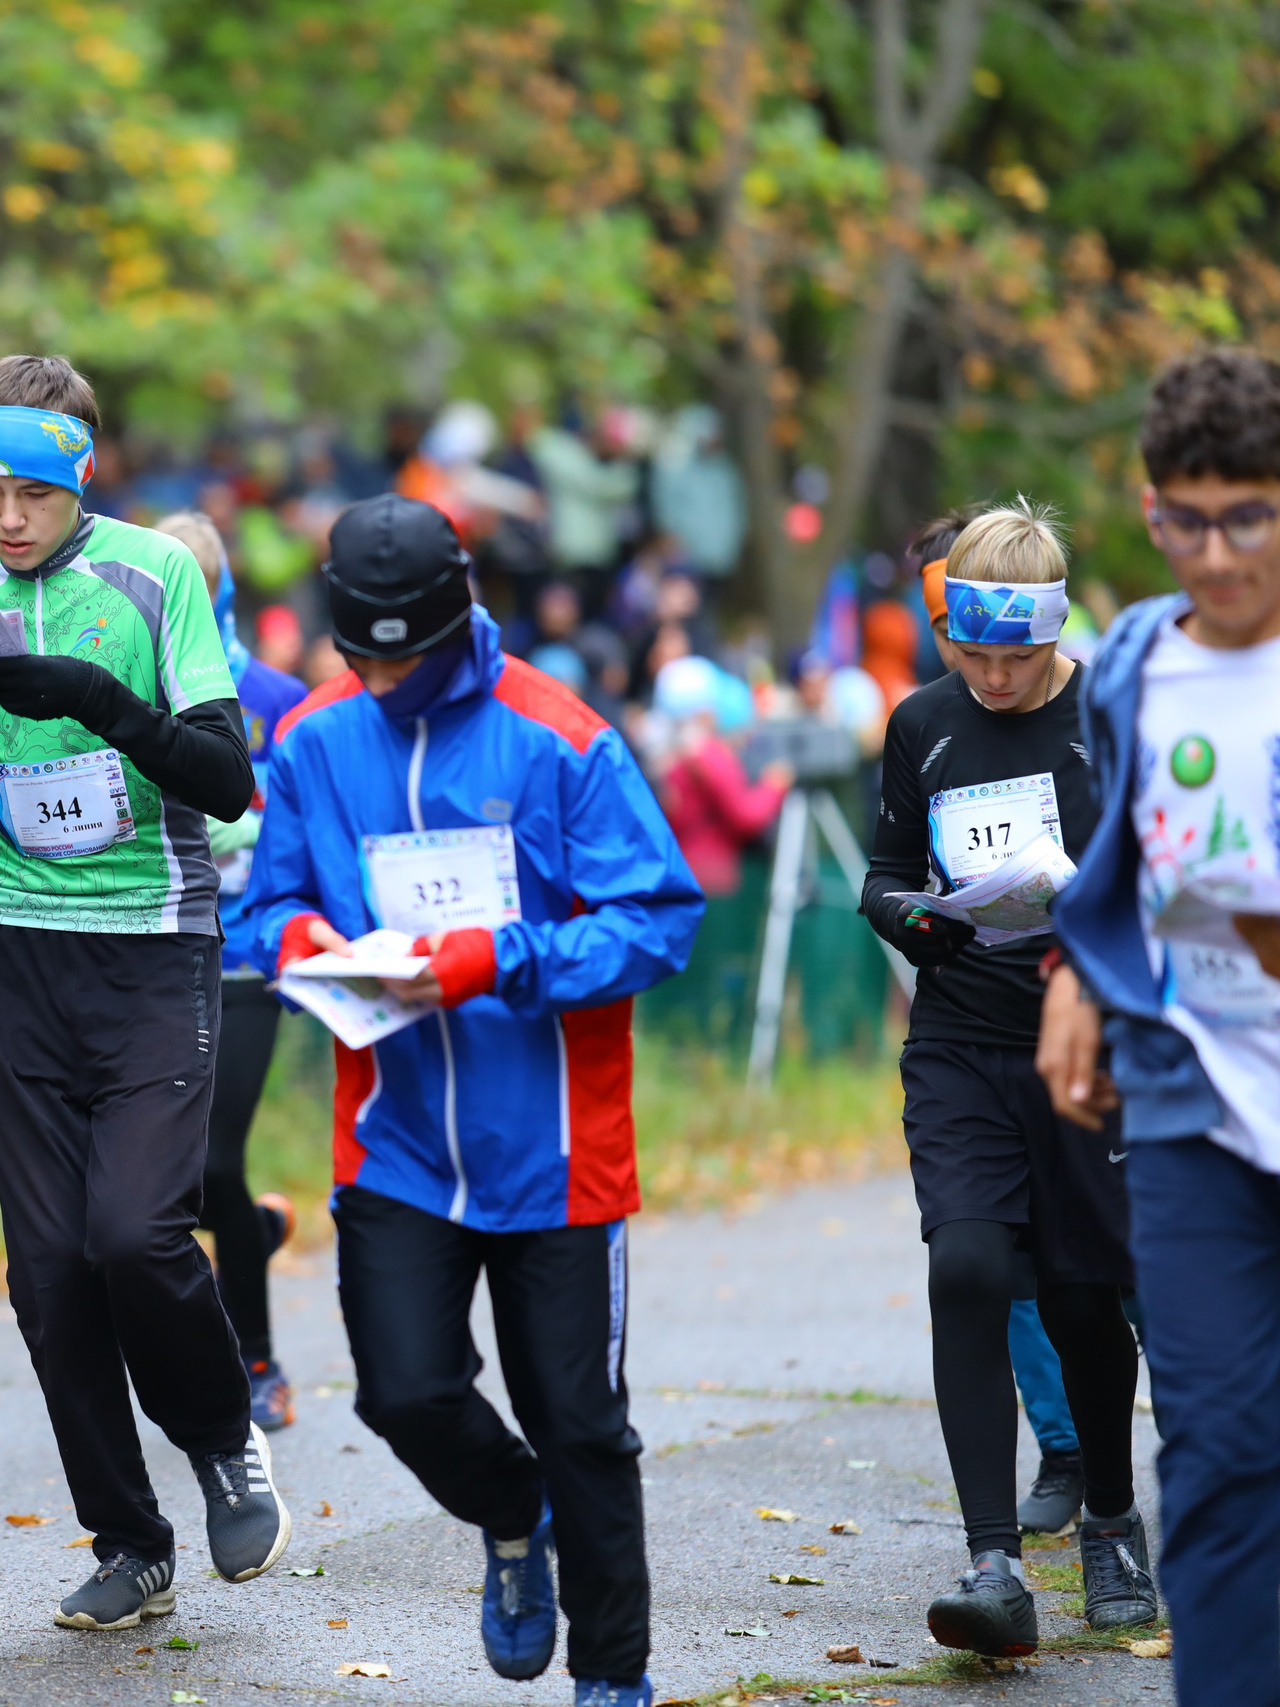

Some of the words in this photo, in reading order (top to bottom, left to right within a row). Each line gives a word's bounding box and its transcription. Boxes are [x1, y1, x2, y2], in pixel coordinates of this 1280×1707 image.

[36, 796, 82, 824] 344
[71, 821, 103, 833] линия
[967, 822, 1011, 851] 317
[51, 843, 74, 851] РОССИИ
[992, 852, 998, 860] 6
[413, 877, 463, 909] 322
